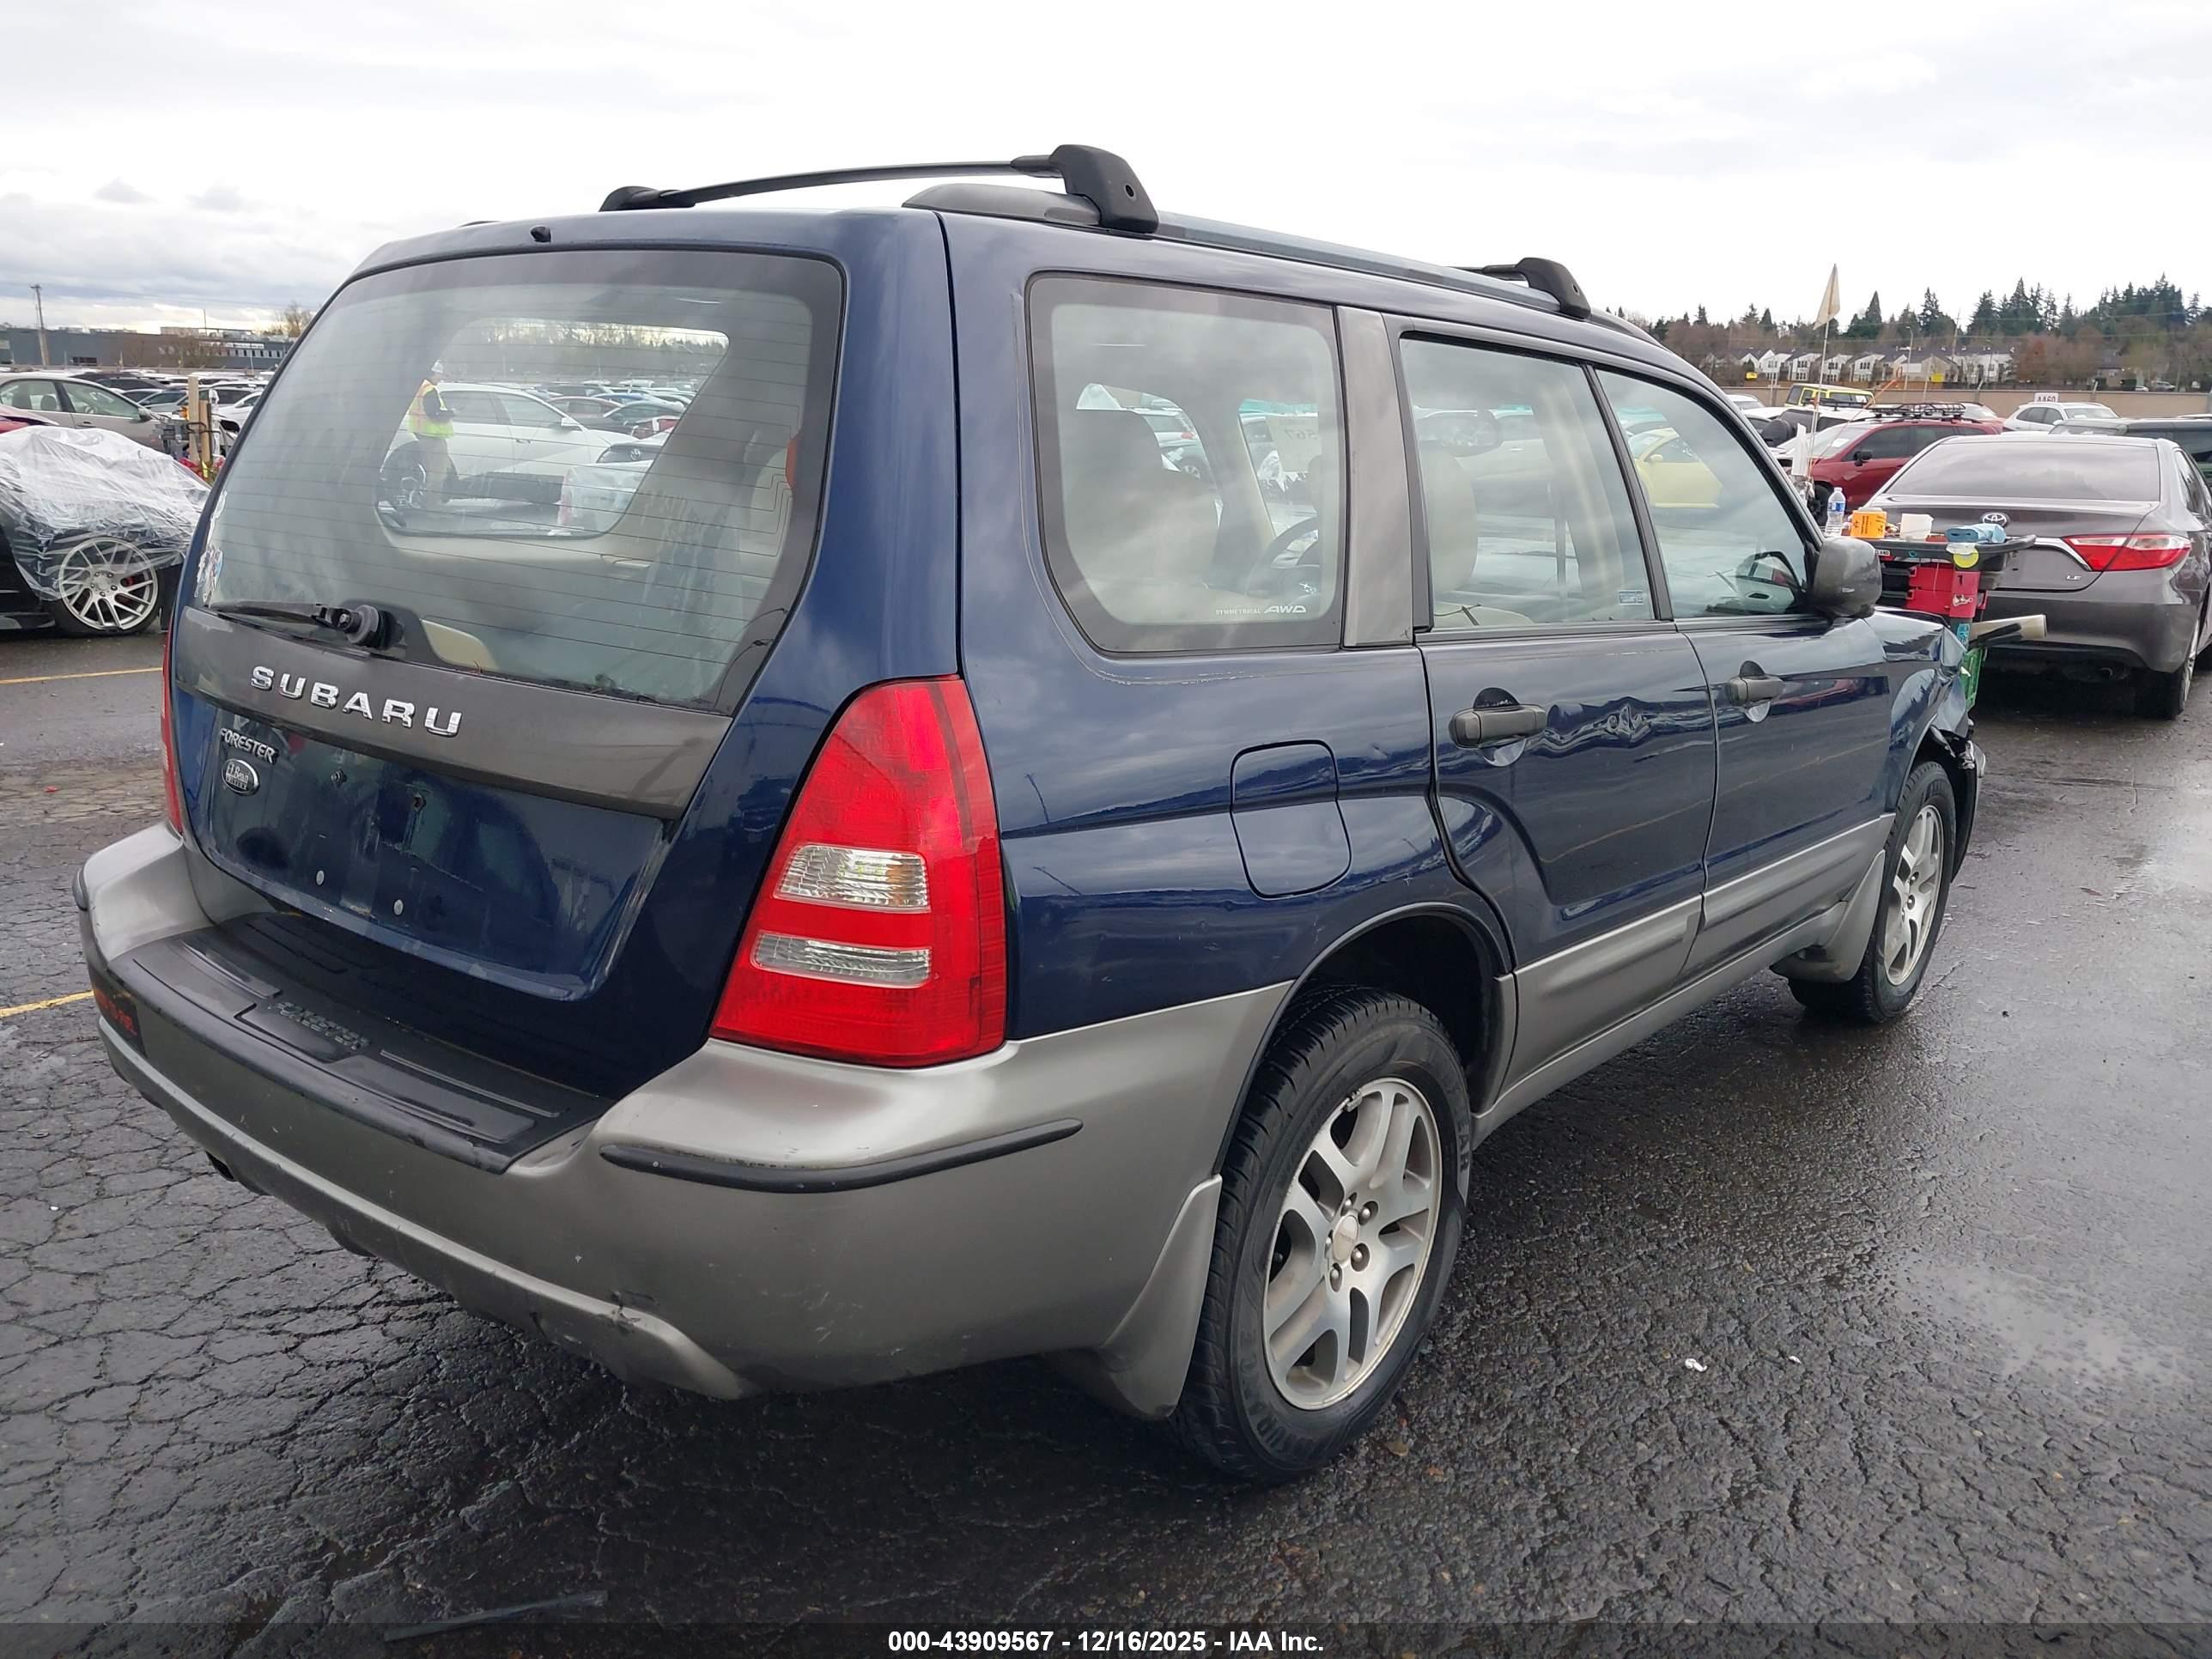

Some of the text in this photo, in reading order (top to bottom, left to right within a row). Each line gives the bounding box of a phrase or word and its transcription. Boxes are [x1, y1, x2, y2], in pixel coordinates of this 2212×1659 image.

[1264, 605, 1307, 614] AWD
[251, 665, 463, 737] SUBARU
[220, 728, 276, 763] FORESTER
